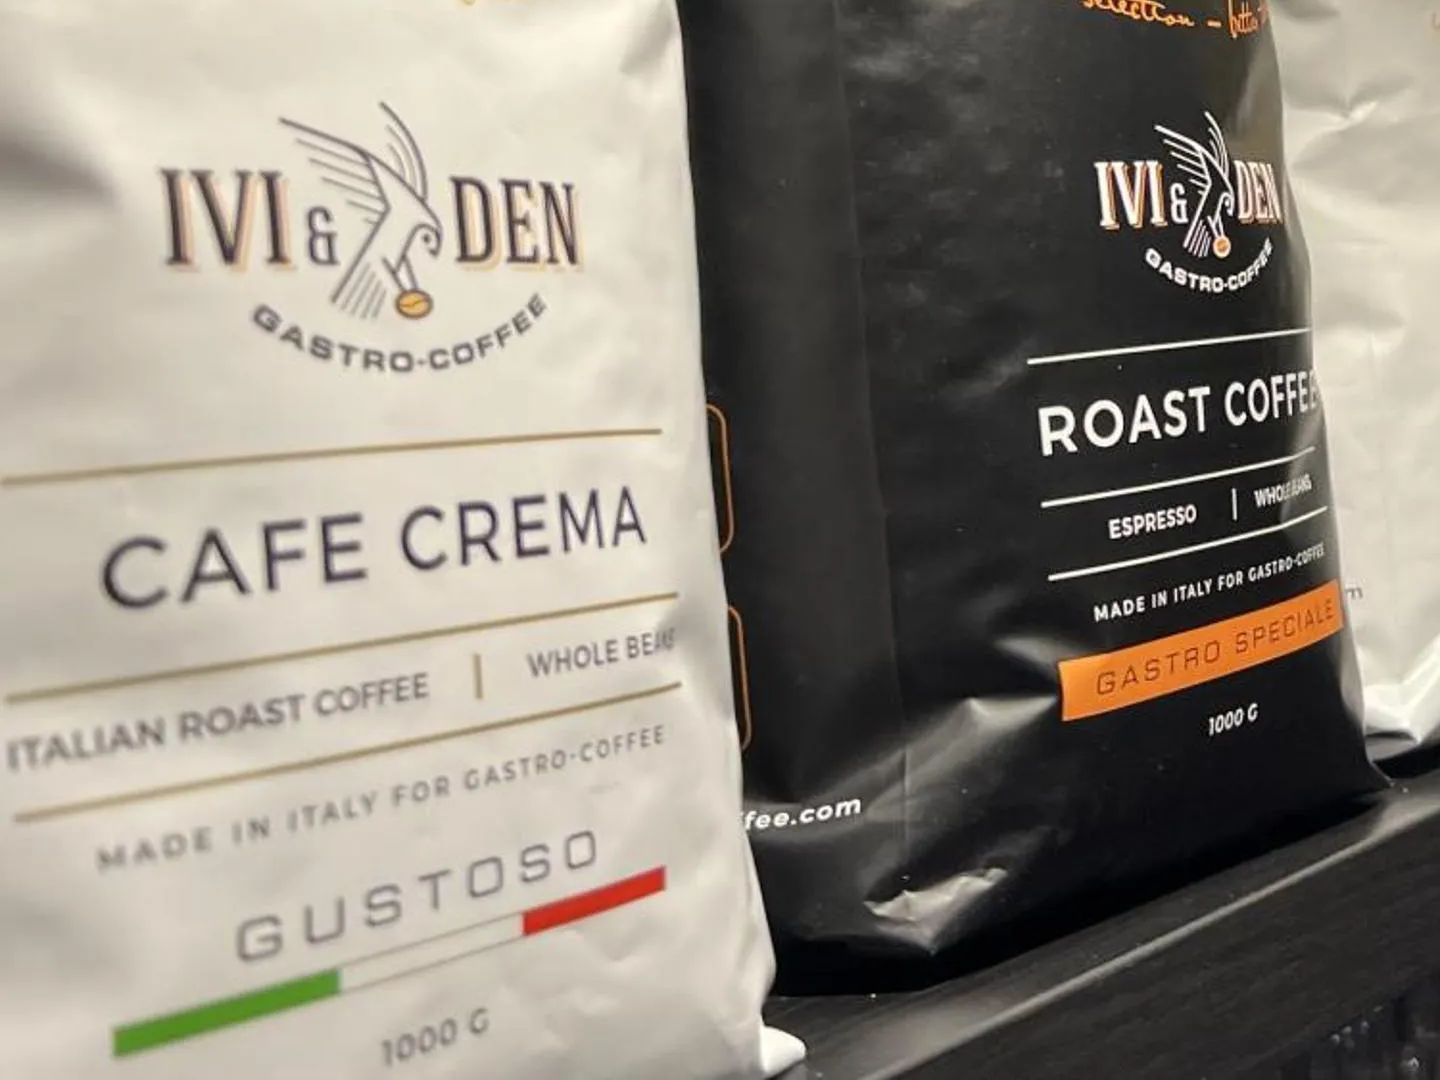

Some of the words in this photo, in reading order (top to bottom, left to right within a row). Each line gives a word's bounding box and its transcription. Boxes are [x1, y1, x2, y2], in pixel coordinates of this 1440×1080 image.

[158, 167, 298, 272] IVI
[307, 206, 340, 267] &
[449, 174, 584, 272] DEN
[1093, 159, 1168, 231] IVI
[1170, 182, 1189, 224] &
[1233, 159, 1285, 225] DEN
[250, 292, 549, 375] GASTRO-COFFEE
[1037, 385, 1211, 456] ROAST
[101, 511, 368, 612] CAFE
[400, 484, 648, 572] CREMA
[1108, 504, 1198, 540] ESPRESSO
[1094, 600, 1146, 622] MADE
[1151, 593, 1169, 609] IN
[1173, 579, 1213, 604] ITALY
[1217, 569, 1245, 592] FOR
[526, 638, 620, 678] WHOLE
[1095, 639, 1221, 696] GASTRO
[1234, 597, 1335, 654] SPECIALE
[6, 717, 167, 775] ITALIAN
[178, 692, 306, 741] ROAST
[312, 672, 431, 718] COFFEE
[1208, 707, 1245, 736] 1000
[1247, 702, 1259, 721] G
[96, 825, 213, 873] MADE
[232, 816, 270, 845] IN
[286, 789, 379, 834] ITALY
[391, 775, 451, 809] FOR
[463, 724, 666, 792] GASTRO-COFFEE
[235, 829, 599, 964] GUSTOSO
[380, 1016, 460, 1068] 1000
[469, 1007, 491, 1037] G
